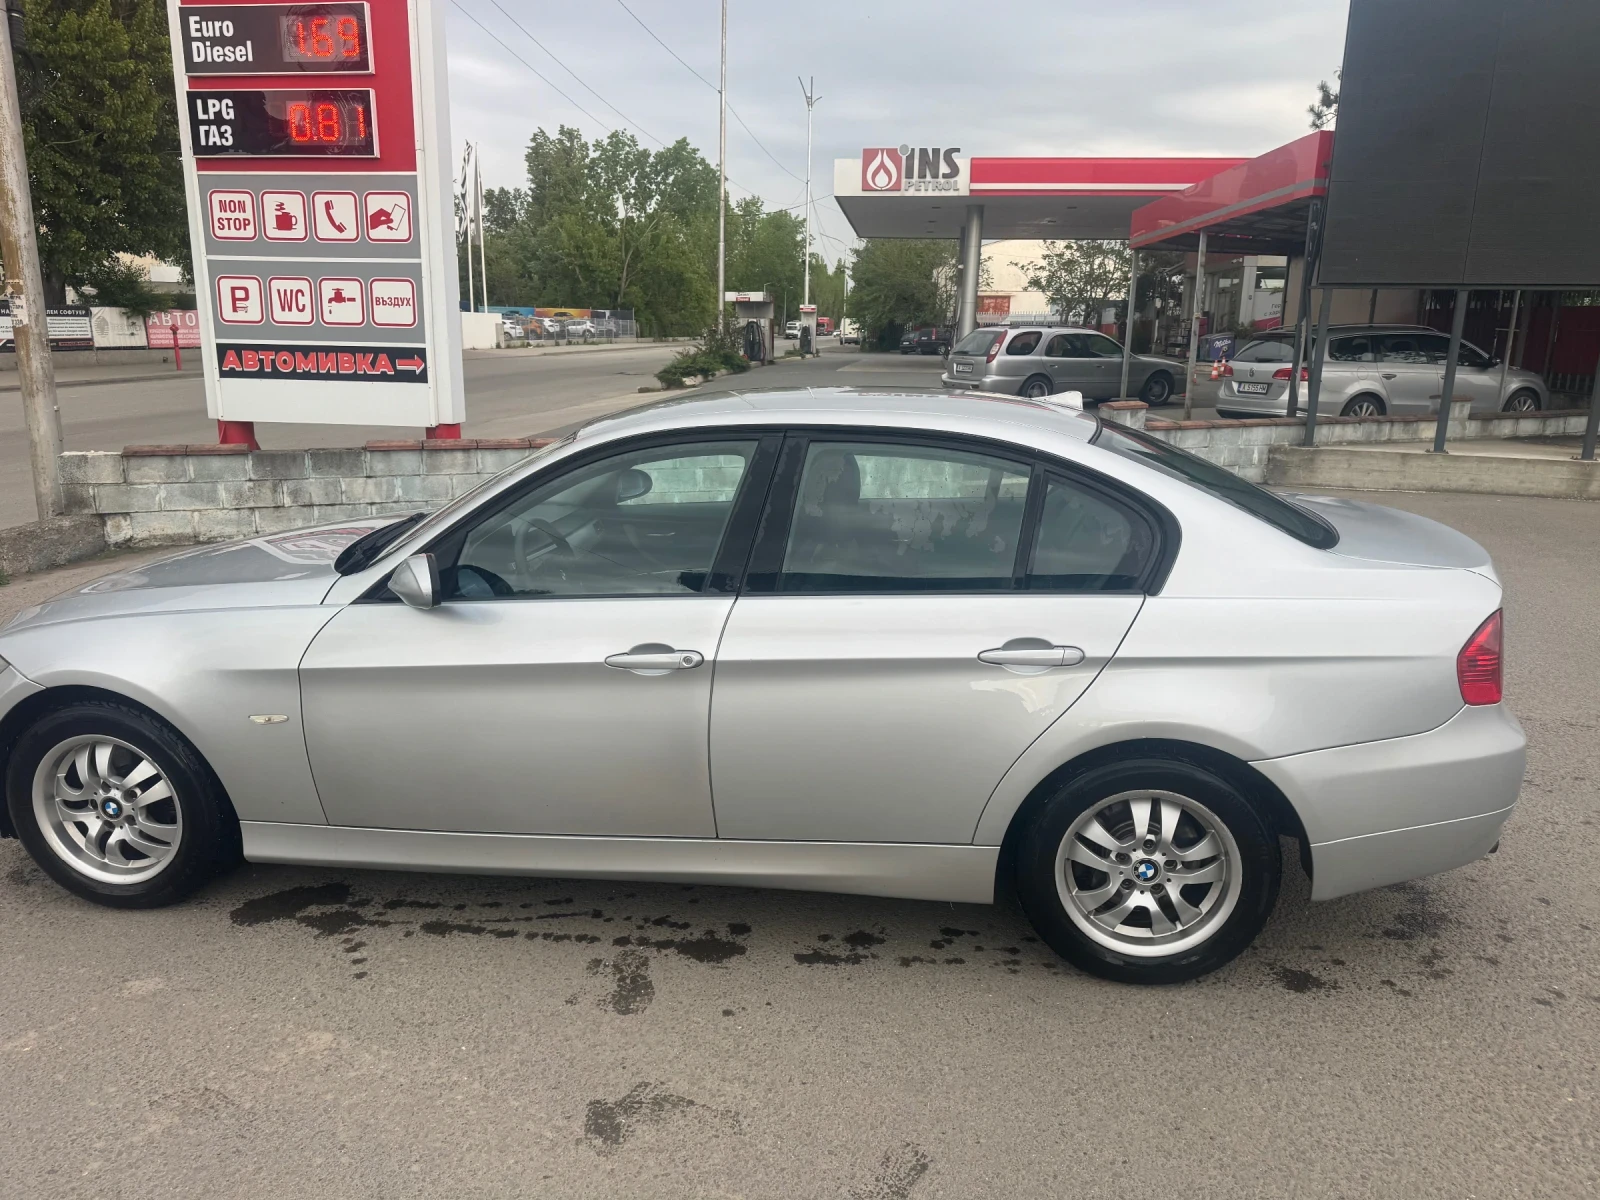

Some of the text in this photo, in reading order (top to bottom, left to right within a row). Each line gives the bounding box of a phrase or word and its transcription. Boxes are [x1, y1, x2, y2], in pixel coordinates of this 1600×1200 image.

[188, 16, 234, 38] Euro
[191, 40, 253, 63] Diesel
[196, 98, 235, 120] LPG
[199, 125, 234, 146] ГАЗ
[904, 180, 960, 192] PETROL
[218, 199, 247, 214] NON
[217, 217, 251, 232] STOP
[276, 288, 306, 313] WC
[375, 296, 412, 308] ВЪЗДУХ
[222, 349, 395, 375] АВТОМИВКА
